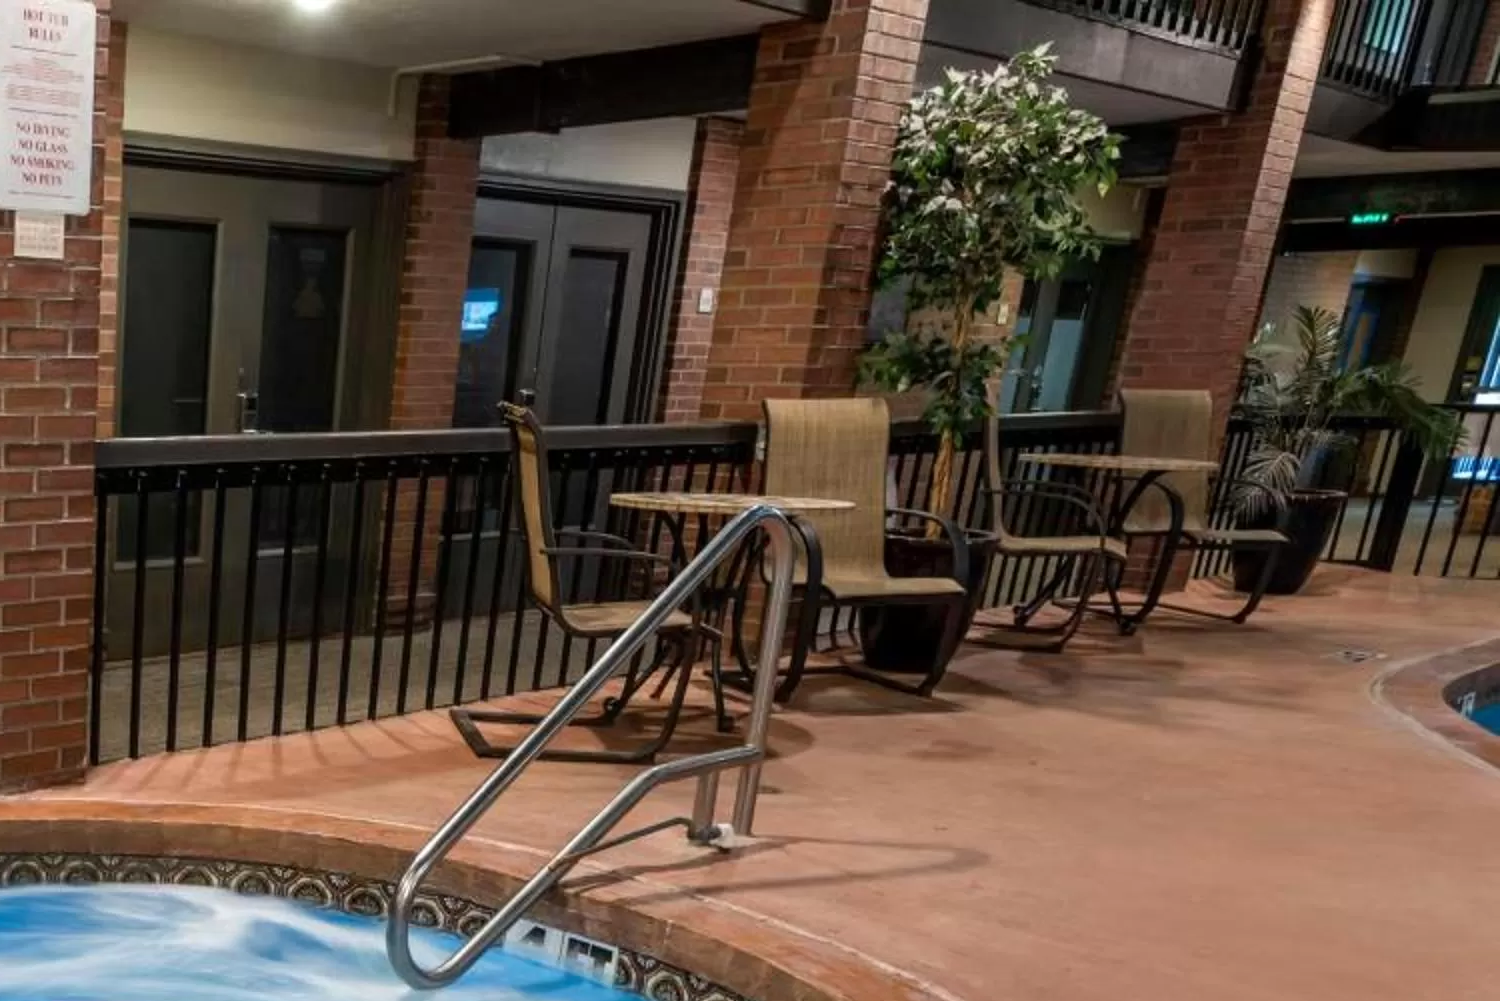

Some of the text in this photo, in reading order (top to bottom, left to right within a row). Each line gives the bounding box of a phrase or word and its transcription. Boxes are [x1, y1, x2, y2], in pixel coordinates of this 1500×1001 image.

[16, 121, 70, 139] NO DIVING
[17, 139, 69, 154] NO GLASS
[10, 154, 76, 171] NO SMOKING
[22, 172, 63, 187] NO PETS
